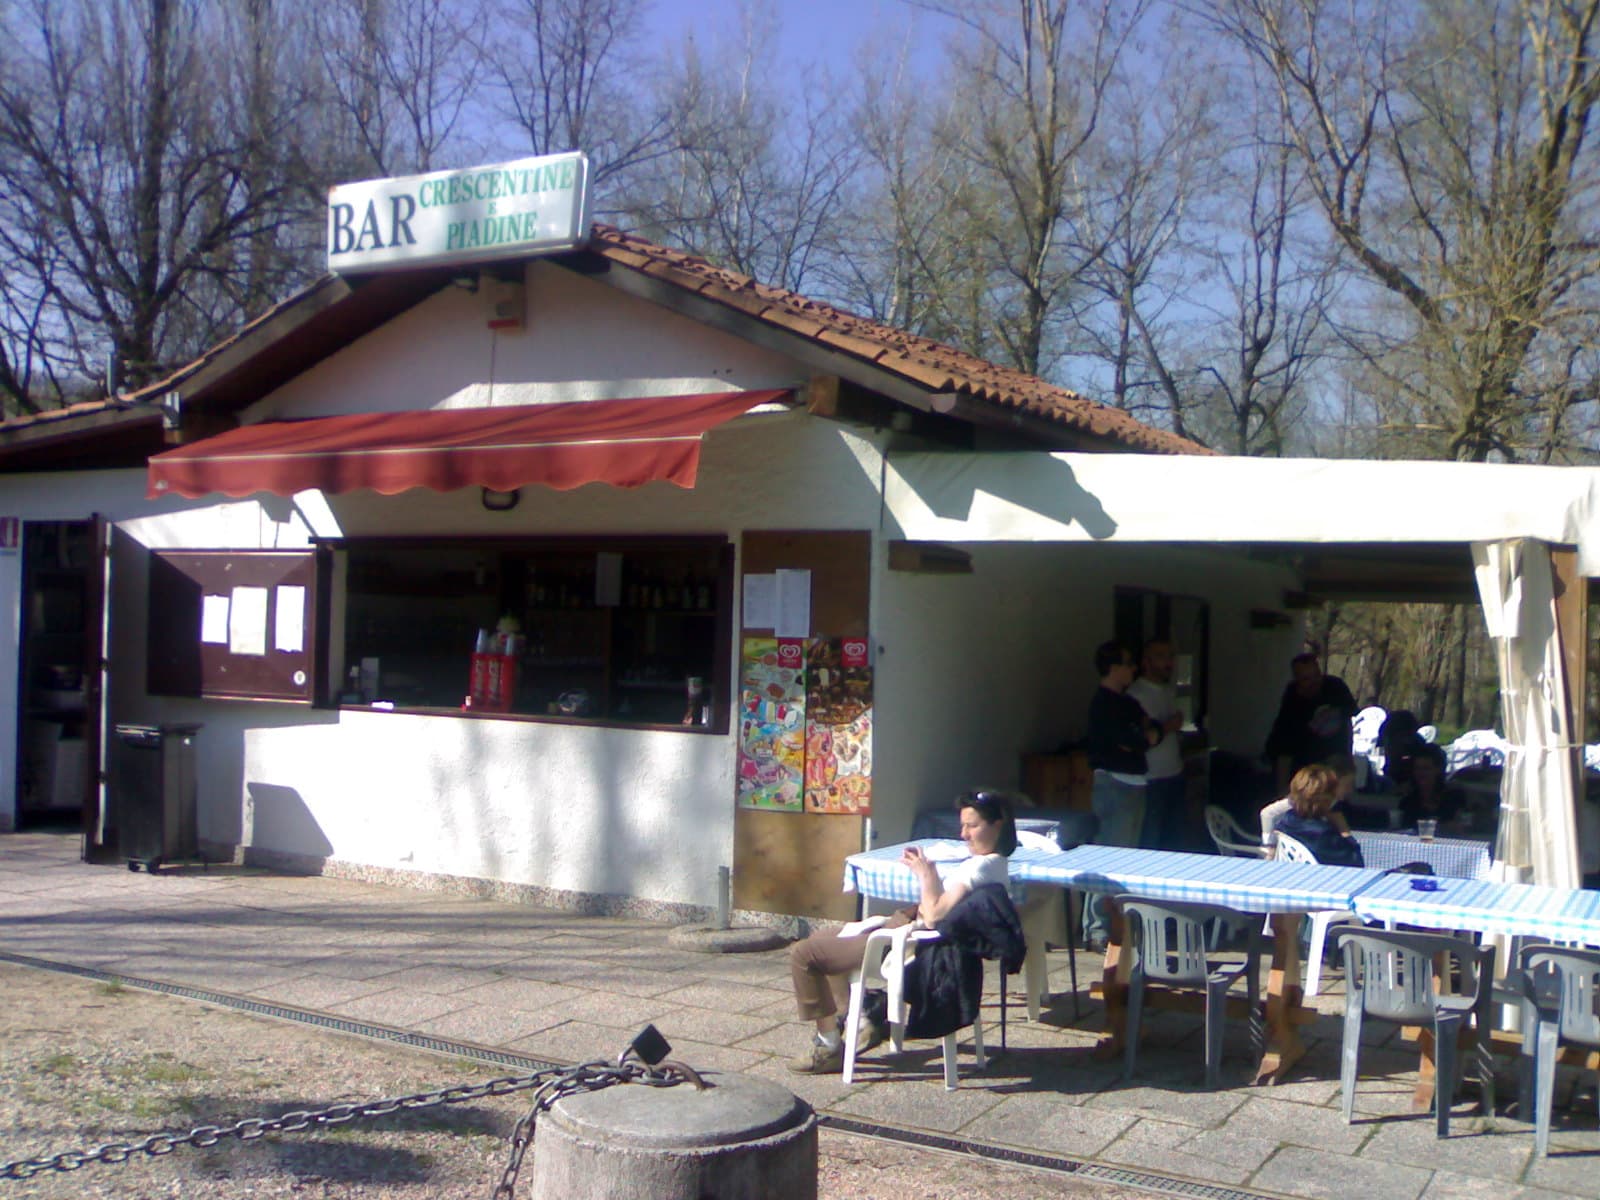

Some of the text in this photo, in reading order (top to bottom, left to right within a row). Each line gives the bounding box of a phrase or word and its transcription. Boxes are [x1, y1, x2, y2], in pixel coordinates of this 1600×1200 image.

[419, 161, 575, 208] CRESCENTINE
[331, 194, 417, 255] BAR
[446, 211, 538, 250] PIADINE
